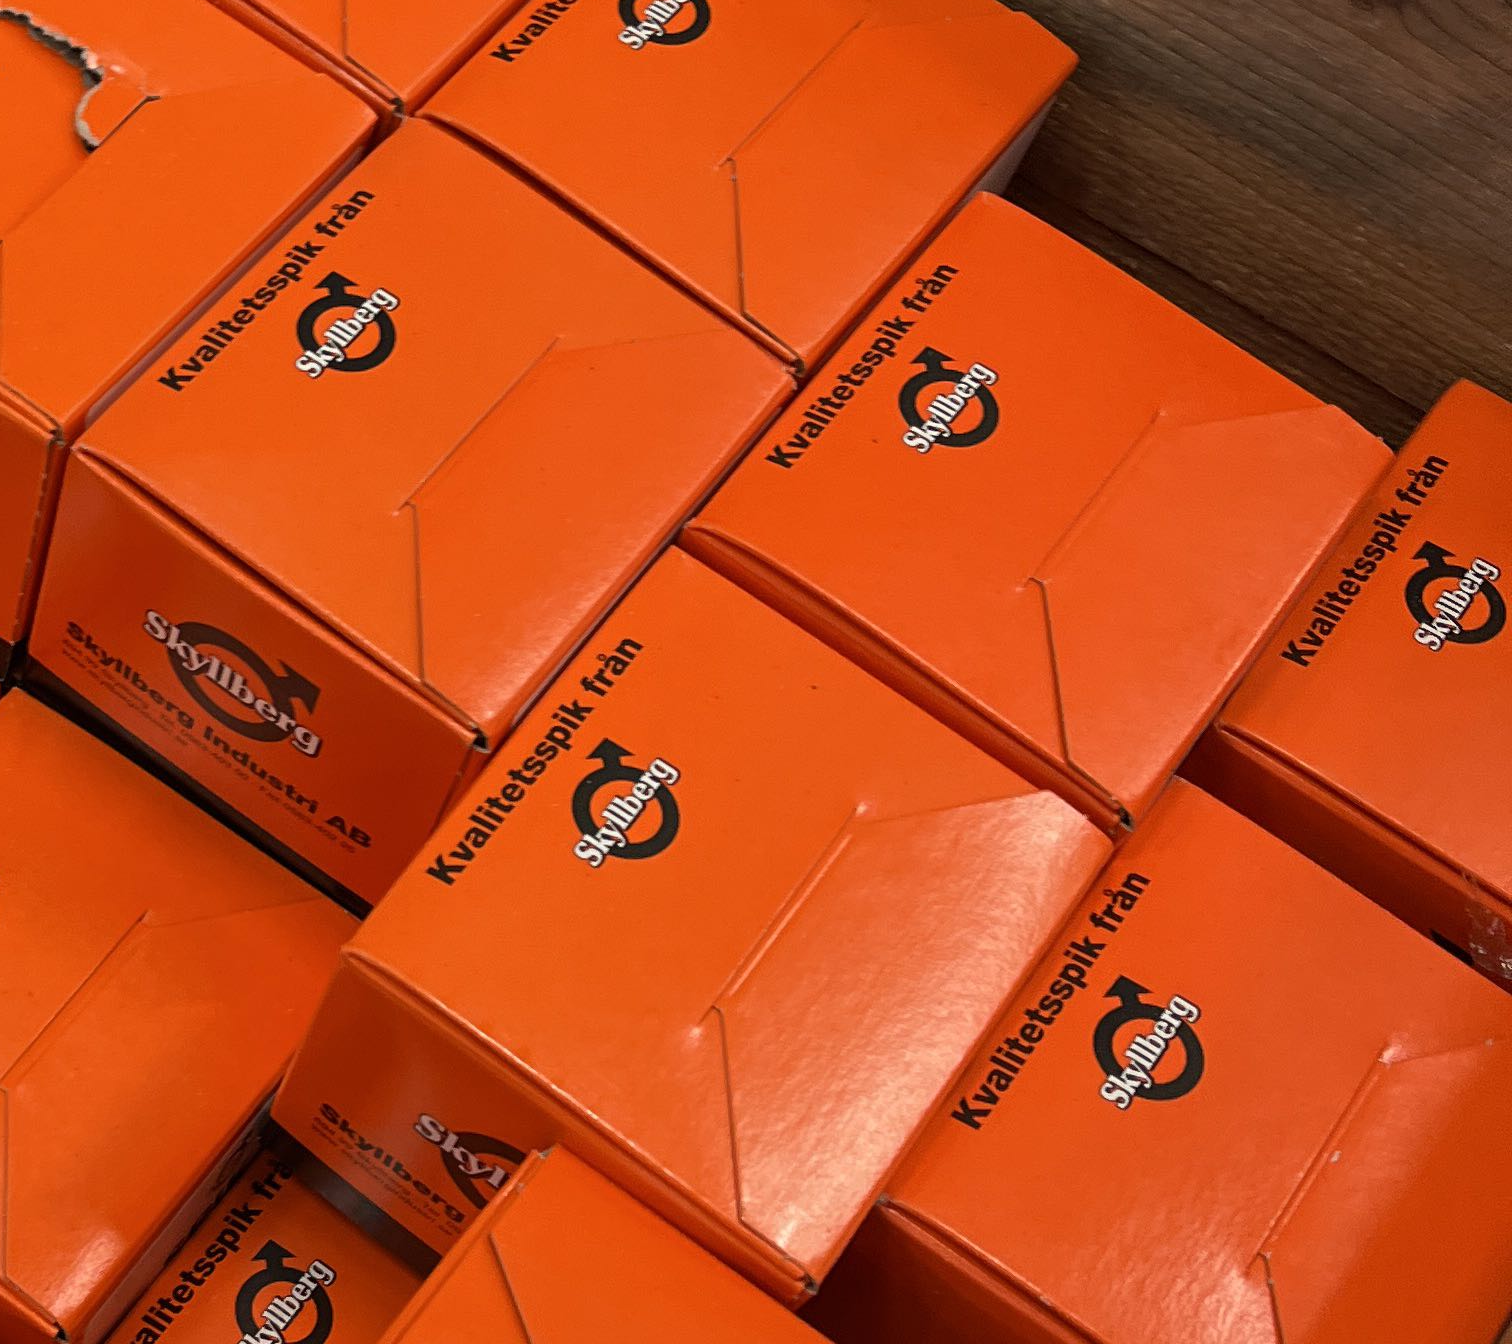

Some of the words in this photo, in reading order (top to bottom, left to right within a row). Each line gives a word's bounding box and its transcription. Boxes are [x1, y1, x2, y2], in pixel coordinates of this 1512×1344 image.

[158, 239, 324, 392] Kvalitetsspik
[316, 188, 374, 244] från
[295, 286, 399, 378] Skyllberg
[765, 314, 916, 469] Kvalitetsspik
[904, 264, 958, 319] från
[902, 362, 998, 454] Skyllberg
[1282, 509, 1409, 667] Kvalitetsspik
[1398, 453, 1450, 505] från
[1413, 556, 1501, 652] Skyllberg
[66, 618, 195, 732] Skyllberg
[203, 724, 317, 815] Industri
[324, 812, 372, 850] AB
[143, 609, 322, 759] Skyllberg
[426, 700, 593, 886] Kvalitetsspik
[582, 637, 644, 697] från
[572, 758, 680, 868] Skyllberg
[951, 936, 1107, 1130] Kvalitetsspik
[1094, 870, 1151, 933] från
[1099, 995, 1201, 1110] Skyllberg
[318, 1103, 466, 1223] Skyllberg
